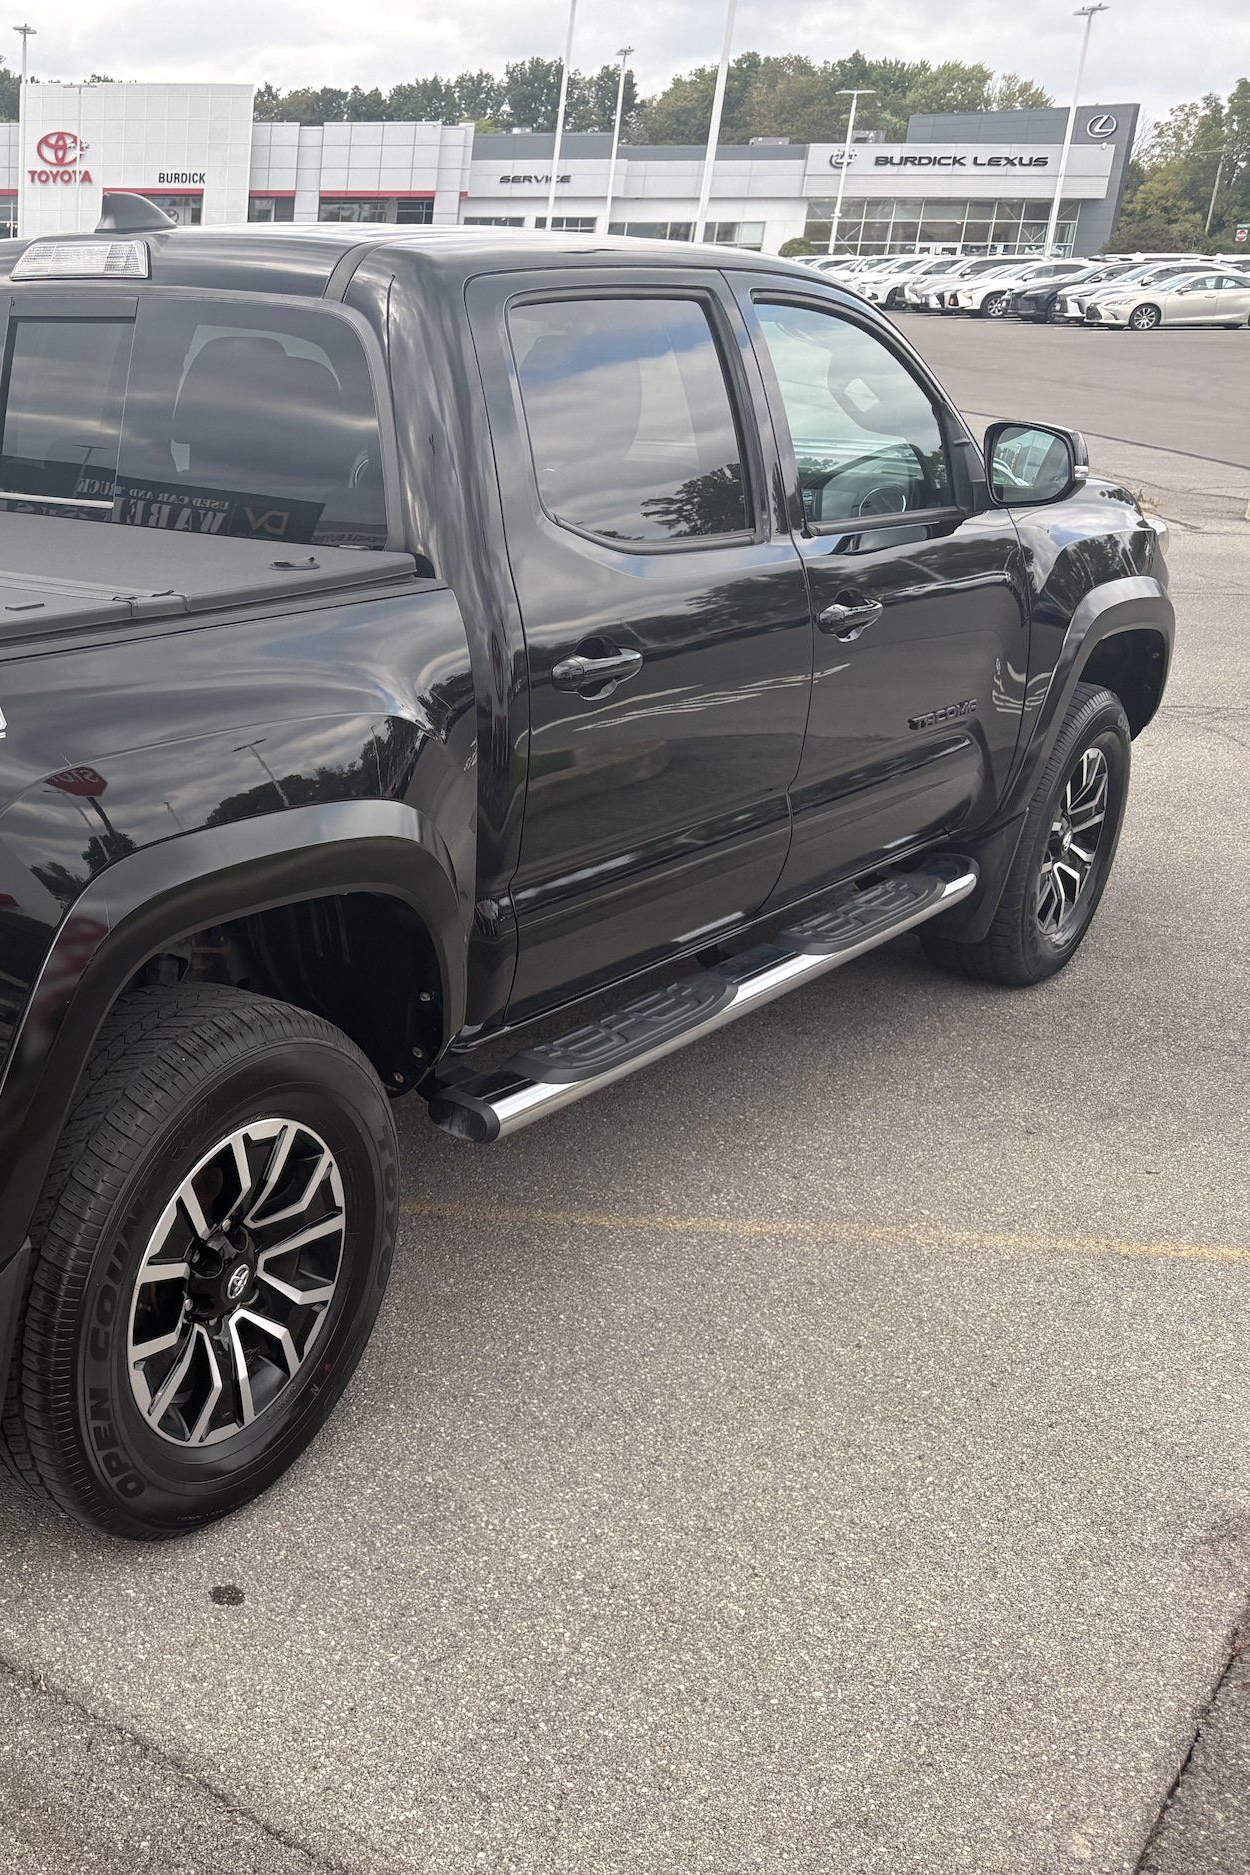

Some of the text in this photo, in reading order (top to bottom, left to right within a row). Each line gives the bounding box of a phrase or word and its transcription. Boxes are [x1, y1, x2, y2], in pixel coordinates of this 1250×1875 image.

[874, 155, 1049, 167] BURDICK LEXUS
[27, 169, 93, 184] TOYOTA
[158, 172, 206, 184] BURDICK
[907, 699, 978, 731] TACOMA
[87, 1386, 146, 1499] OPEN
